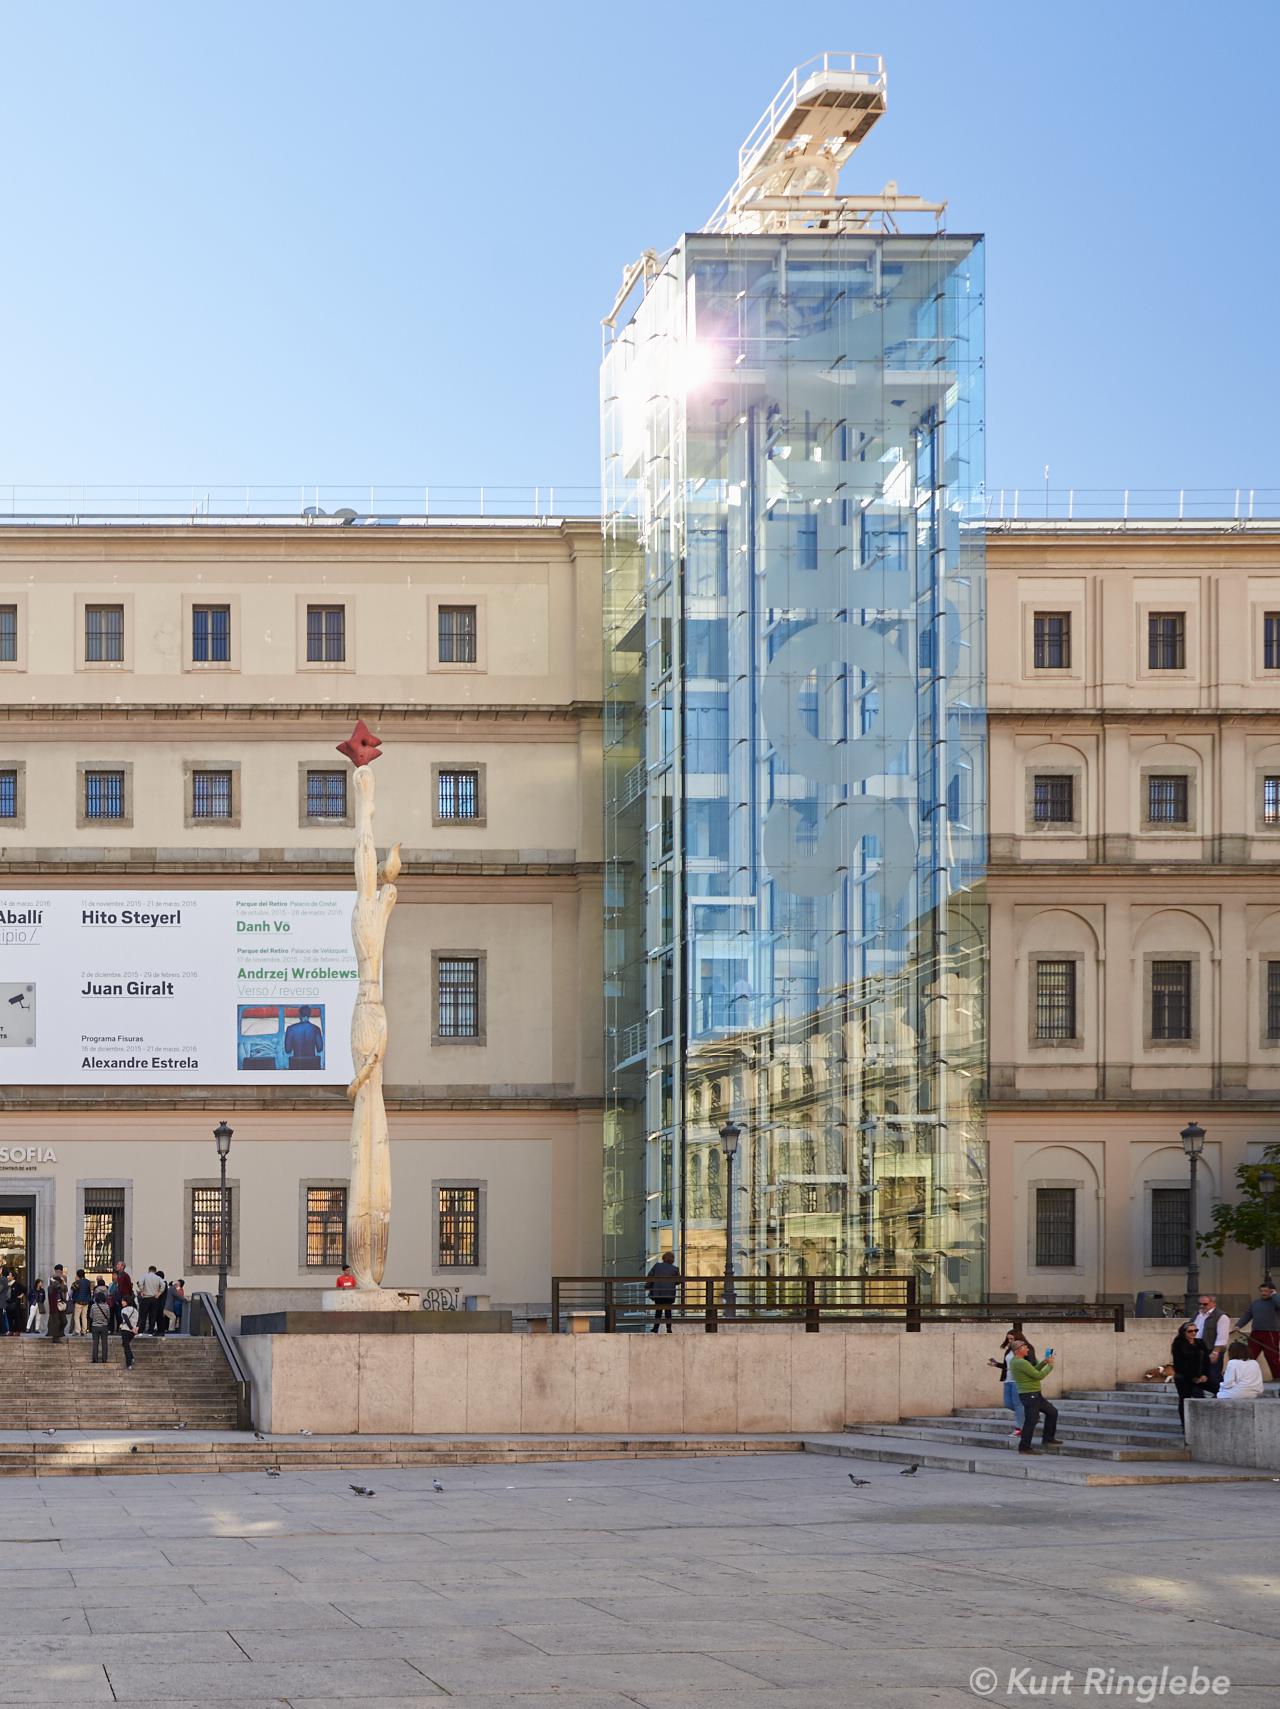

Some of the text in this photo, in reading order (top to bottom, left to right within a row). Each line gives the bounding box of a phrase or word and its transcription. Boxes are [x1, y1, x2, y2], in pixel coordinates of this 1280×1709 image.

[82, 910, 181, 927] Hito Steyerl
[236, 920, 270, 932] Danh
[30, 928, 37, 942] /
[237, 968, 360, 982] Andrzej Wróblews
[82, 981, 174, 995] Juan Giralt
[238, 984, 320, 996] Verso / reverso
[82, 1035, 116, 1043] Programa
[81, 1056, 199, 1068] Alexandre Estrela
